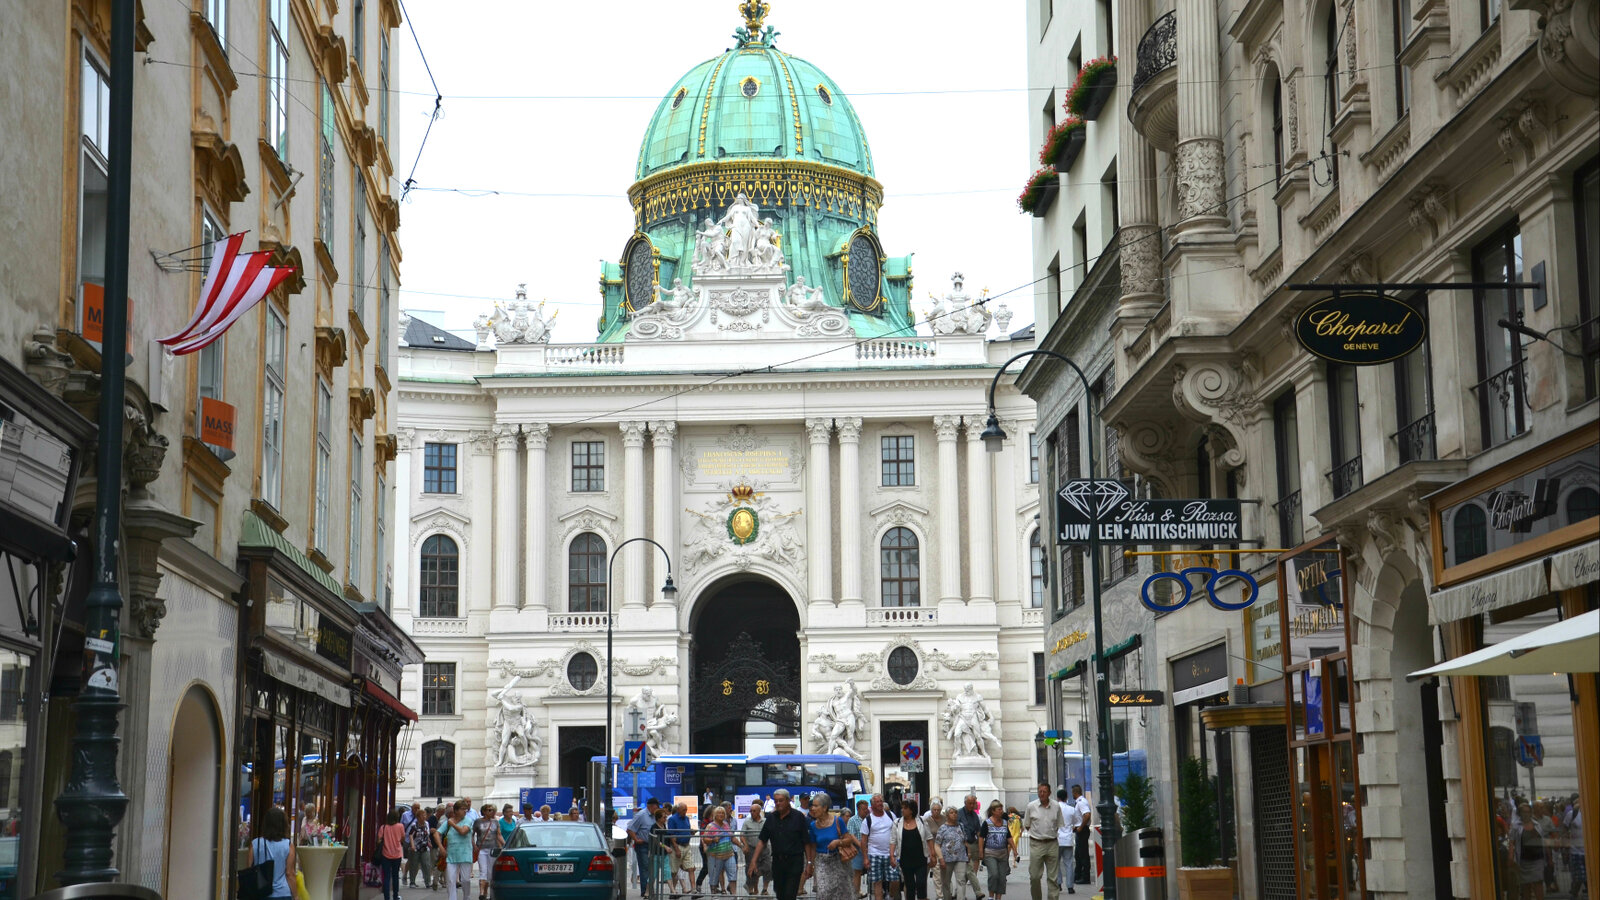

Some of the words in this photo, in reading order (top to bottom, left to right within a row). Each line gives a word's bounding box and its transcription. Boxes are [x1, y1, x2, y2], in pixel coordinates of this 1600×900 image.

[1309, 310, 1410, 341] Chopard
[1115, 501, 1155, 523] Kiss
[1160, 509, 1175, 522] &
[1181, 500, 1238, 522] Rozsa
[1061, 523, 1123, 541] JUWLEN
[1297, 559, 1328, 592] OPTIK
